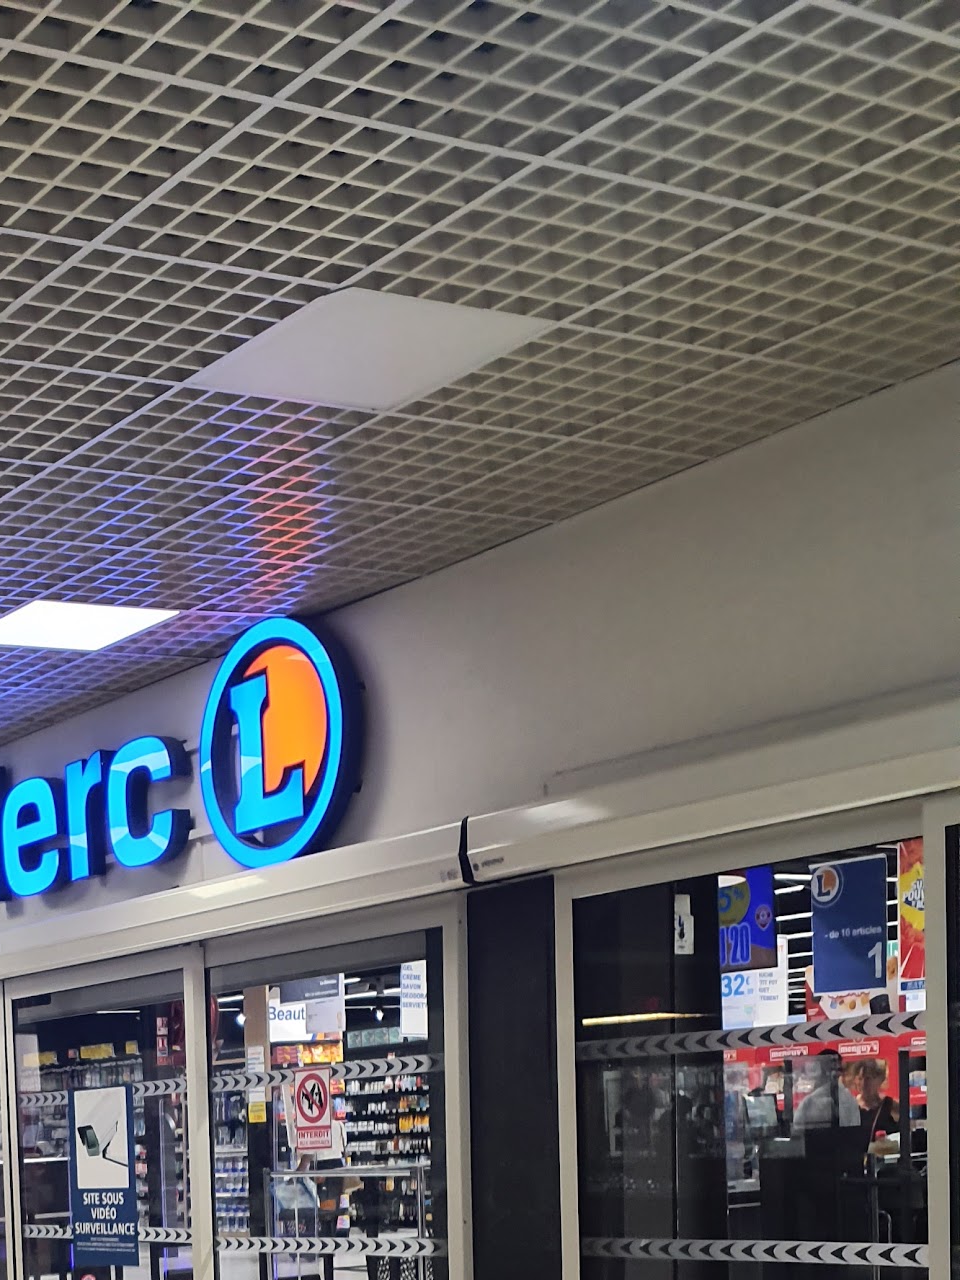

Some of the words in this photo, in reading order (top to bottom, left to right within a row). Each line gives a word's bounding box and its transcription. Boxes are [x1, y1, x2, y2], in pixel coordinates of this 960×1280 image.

[868, 942, 882, 978] 1
[269, 1006, 306, 1021] Beaut
[83, 1192, 100, 1205] SITE
[101, 1191, 124, 1205] SOUS
[91, 1205, 117, 1220] VIDÉO
[75, 1222, 136, 1236] SURVEILLANCE
